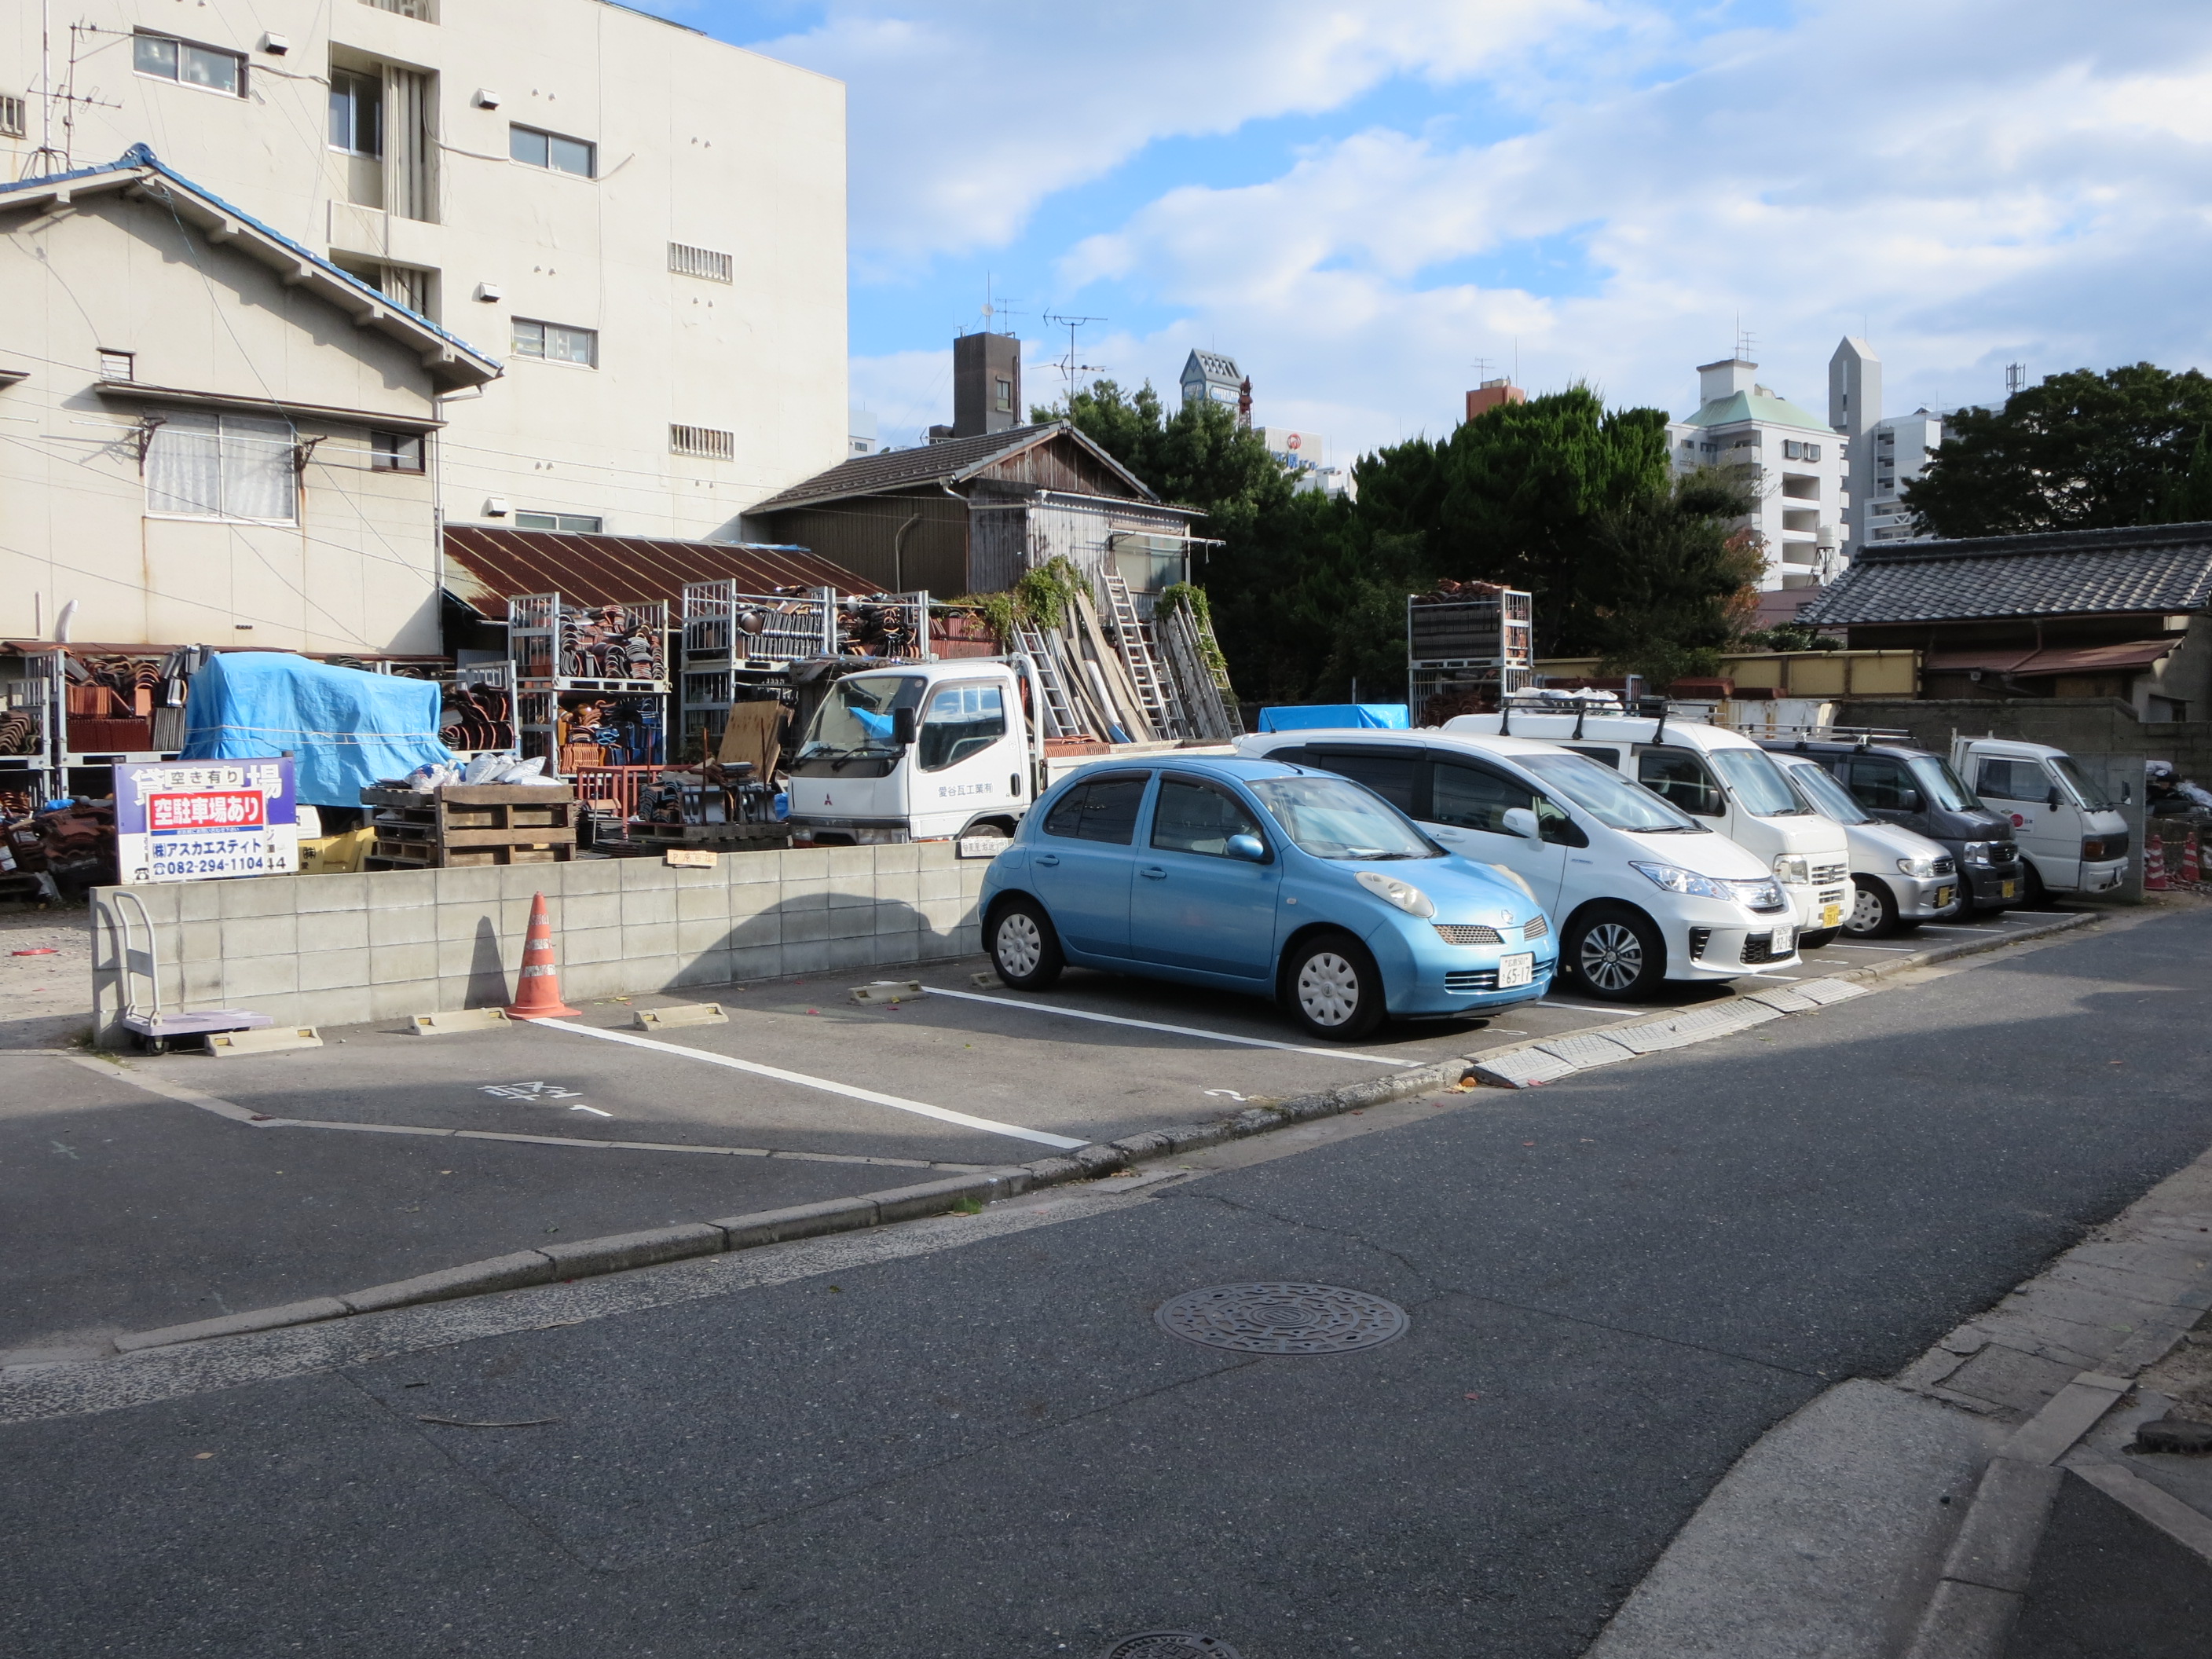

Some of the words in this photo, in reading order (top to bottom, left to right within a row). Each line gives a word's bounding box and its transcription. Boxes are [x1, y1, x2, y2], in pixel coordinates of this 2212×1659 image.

[170, 770, 239, 786] 空き有り
[153, 795, 259, 826] 空駐車場あり
[167, 857, 264, 875] 082-294-1104
[1507, 966, 1530, 984] 65-17
